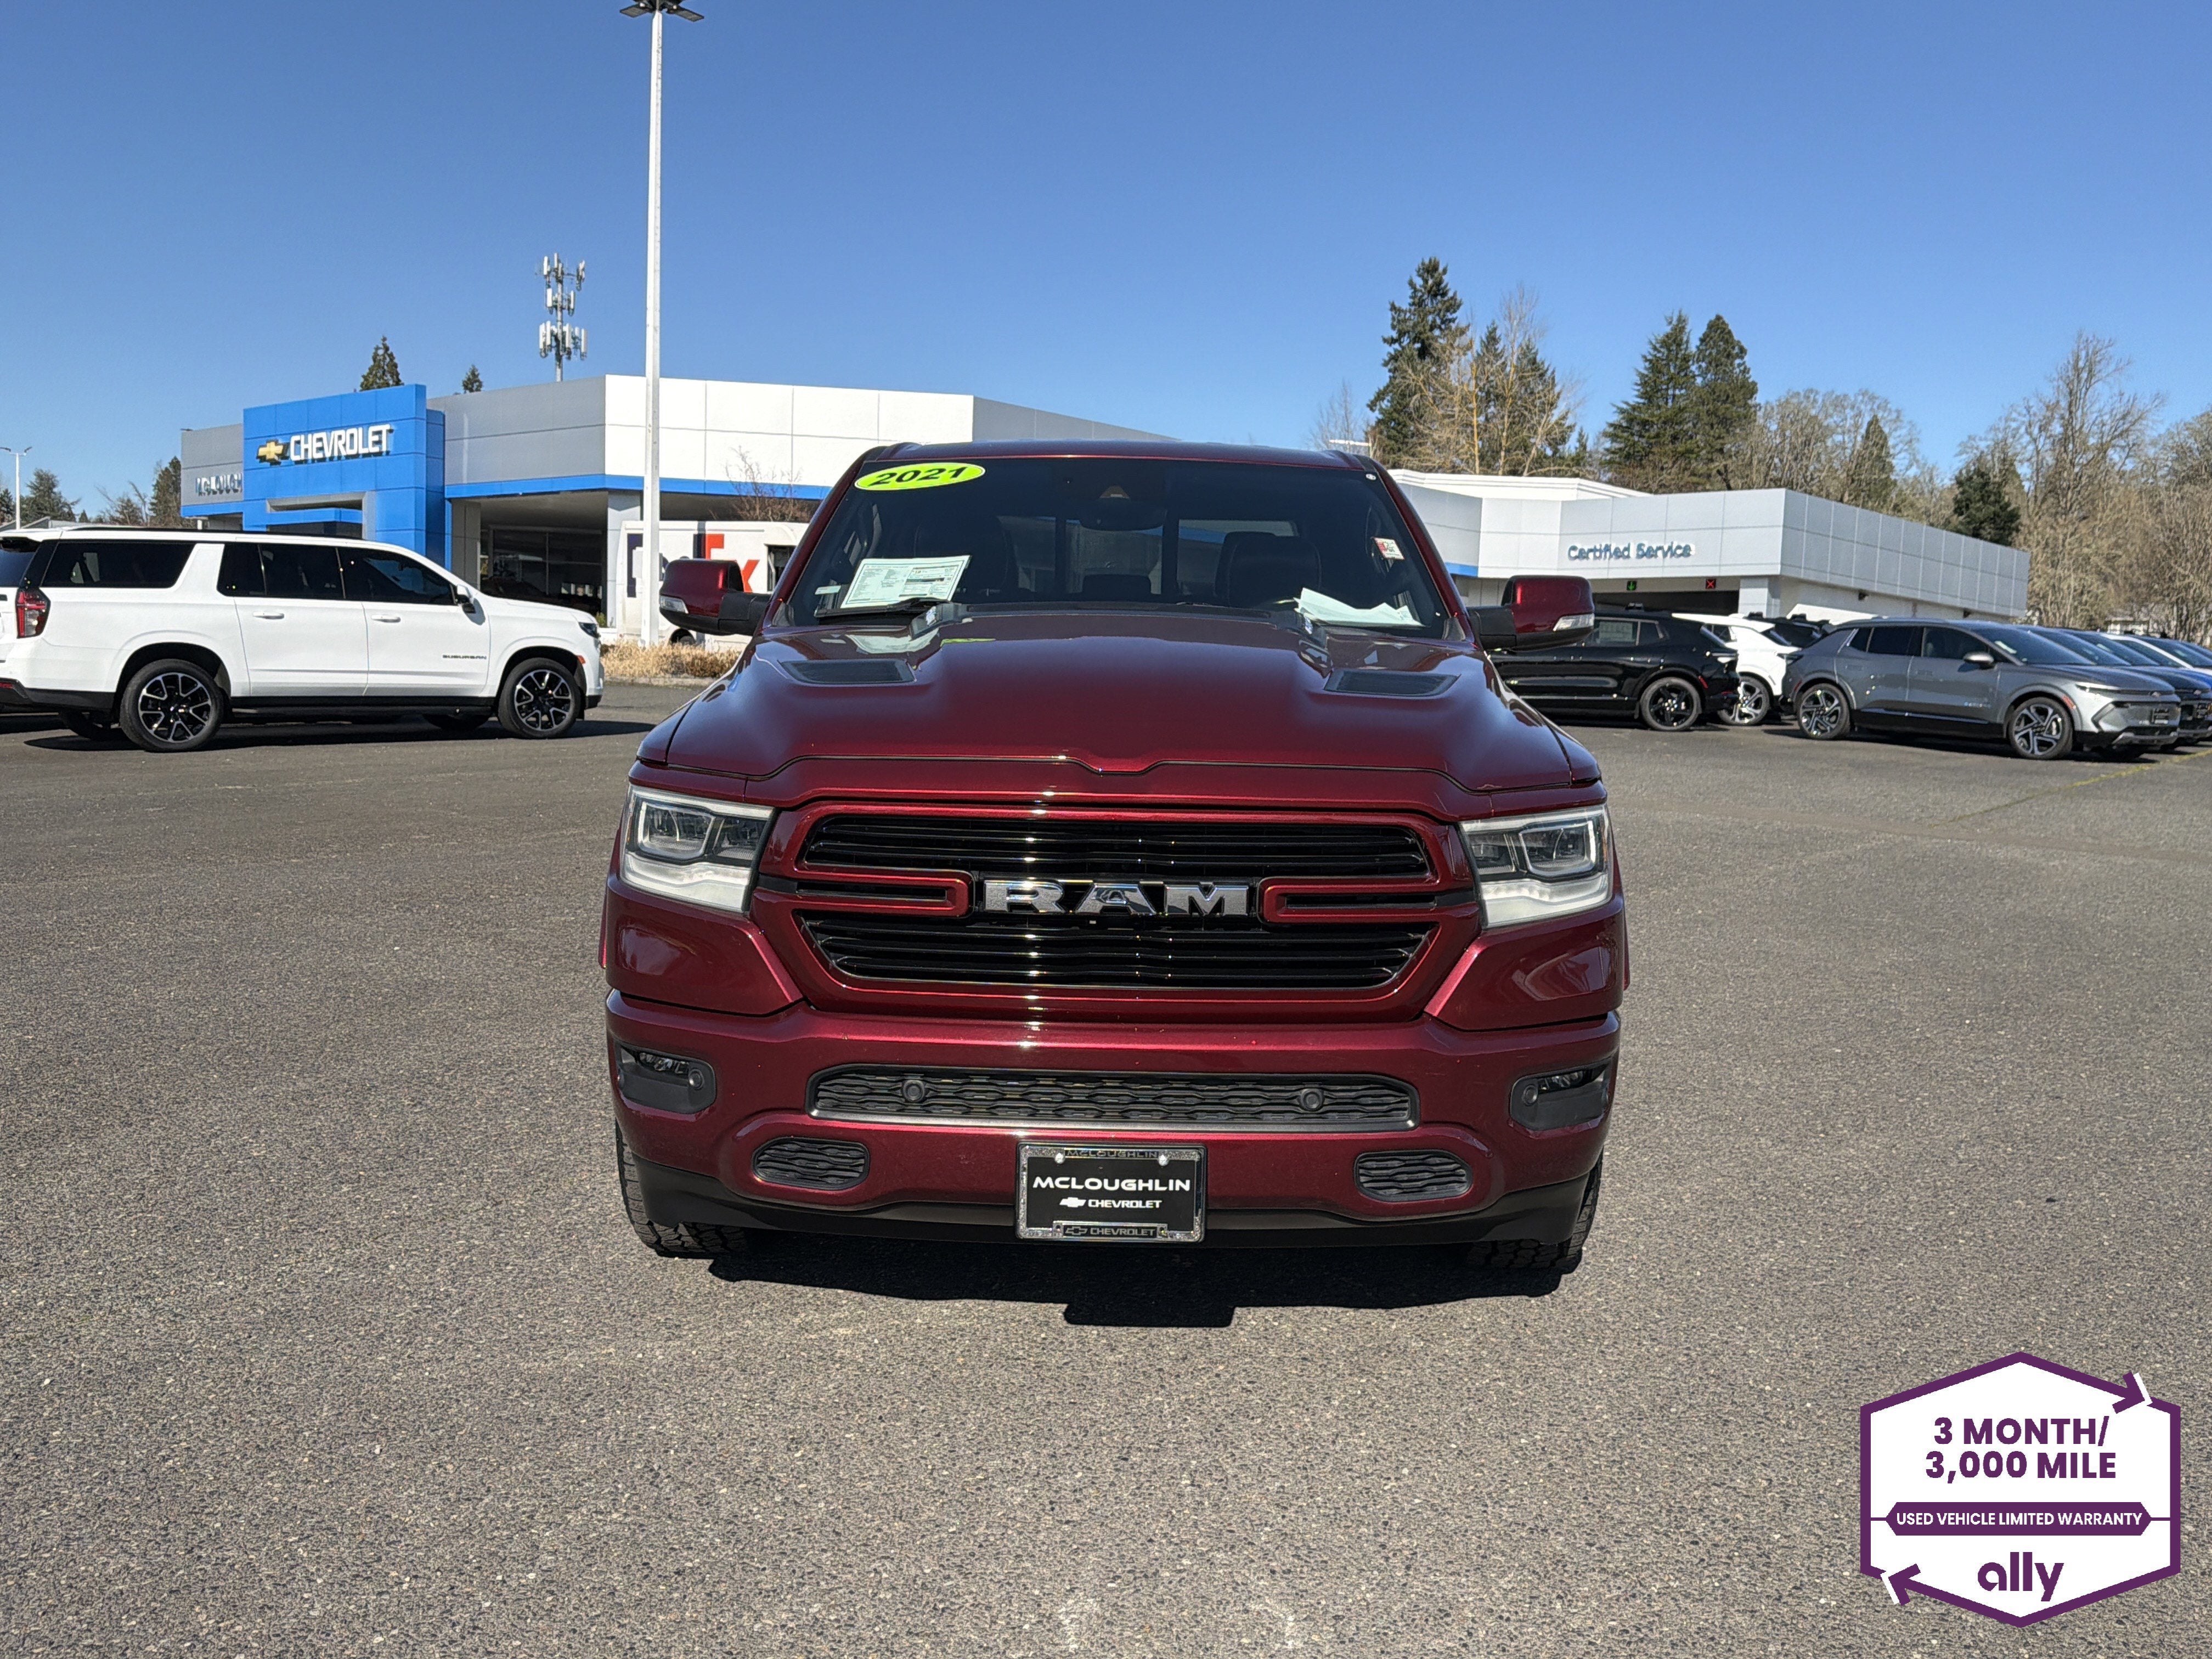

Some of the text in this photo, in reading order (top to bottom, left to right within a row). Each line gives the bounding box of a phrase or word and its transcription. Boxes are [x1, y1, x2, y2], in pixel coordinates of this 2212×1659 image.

[290, 424, 390, 461] CHEVROLET
[867, 466, 968, 487] 2021
[1567, 541, 1692, 561] Certified Service
[984, 879, 1249, 916] RAM
[1066, 1150, 1158, 1158] MCLOUGHLIN
[1032, 1176, 1190, 1191] MCLOUGHLIN
[1088, 1199, 1162, 1208] CHEVROLET
